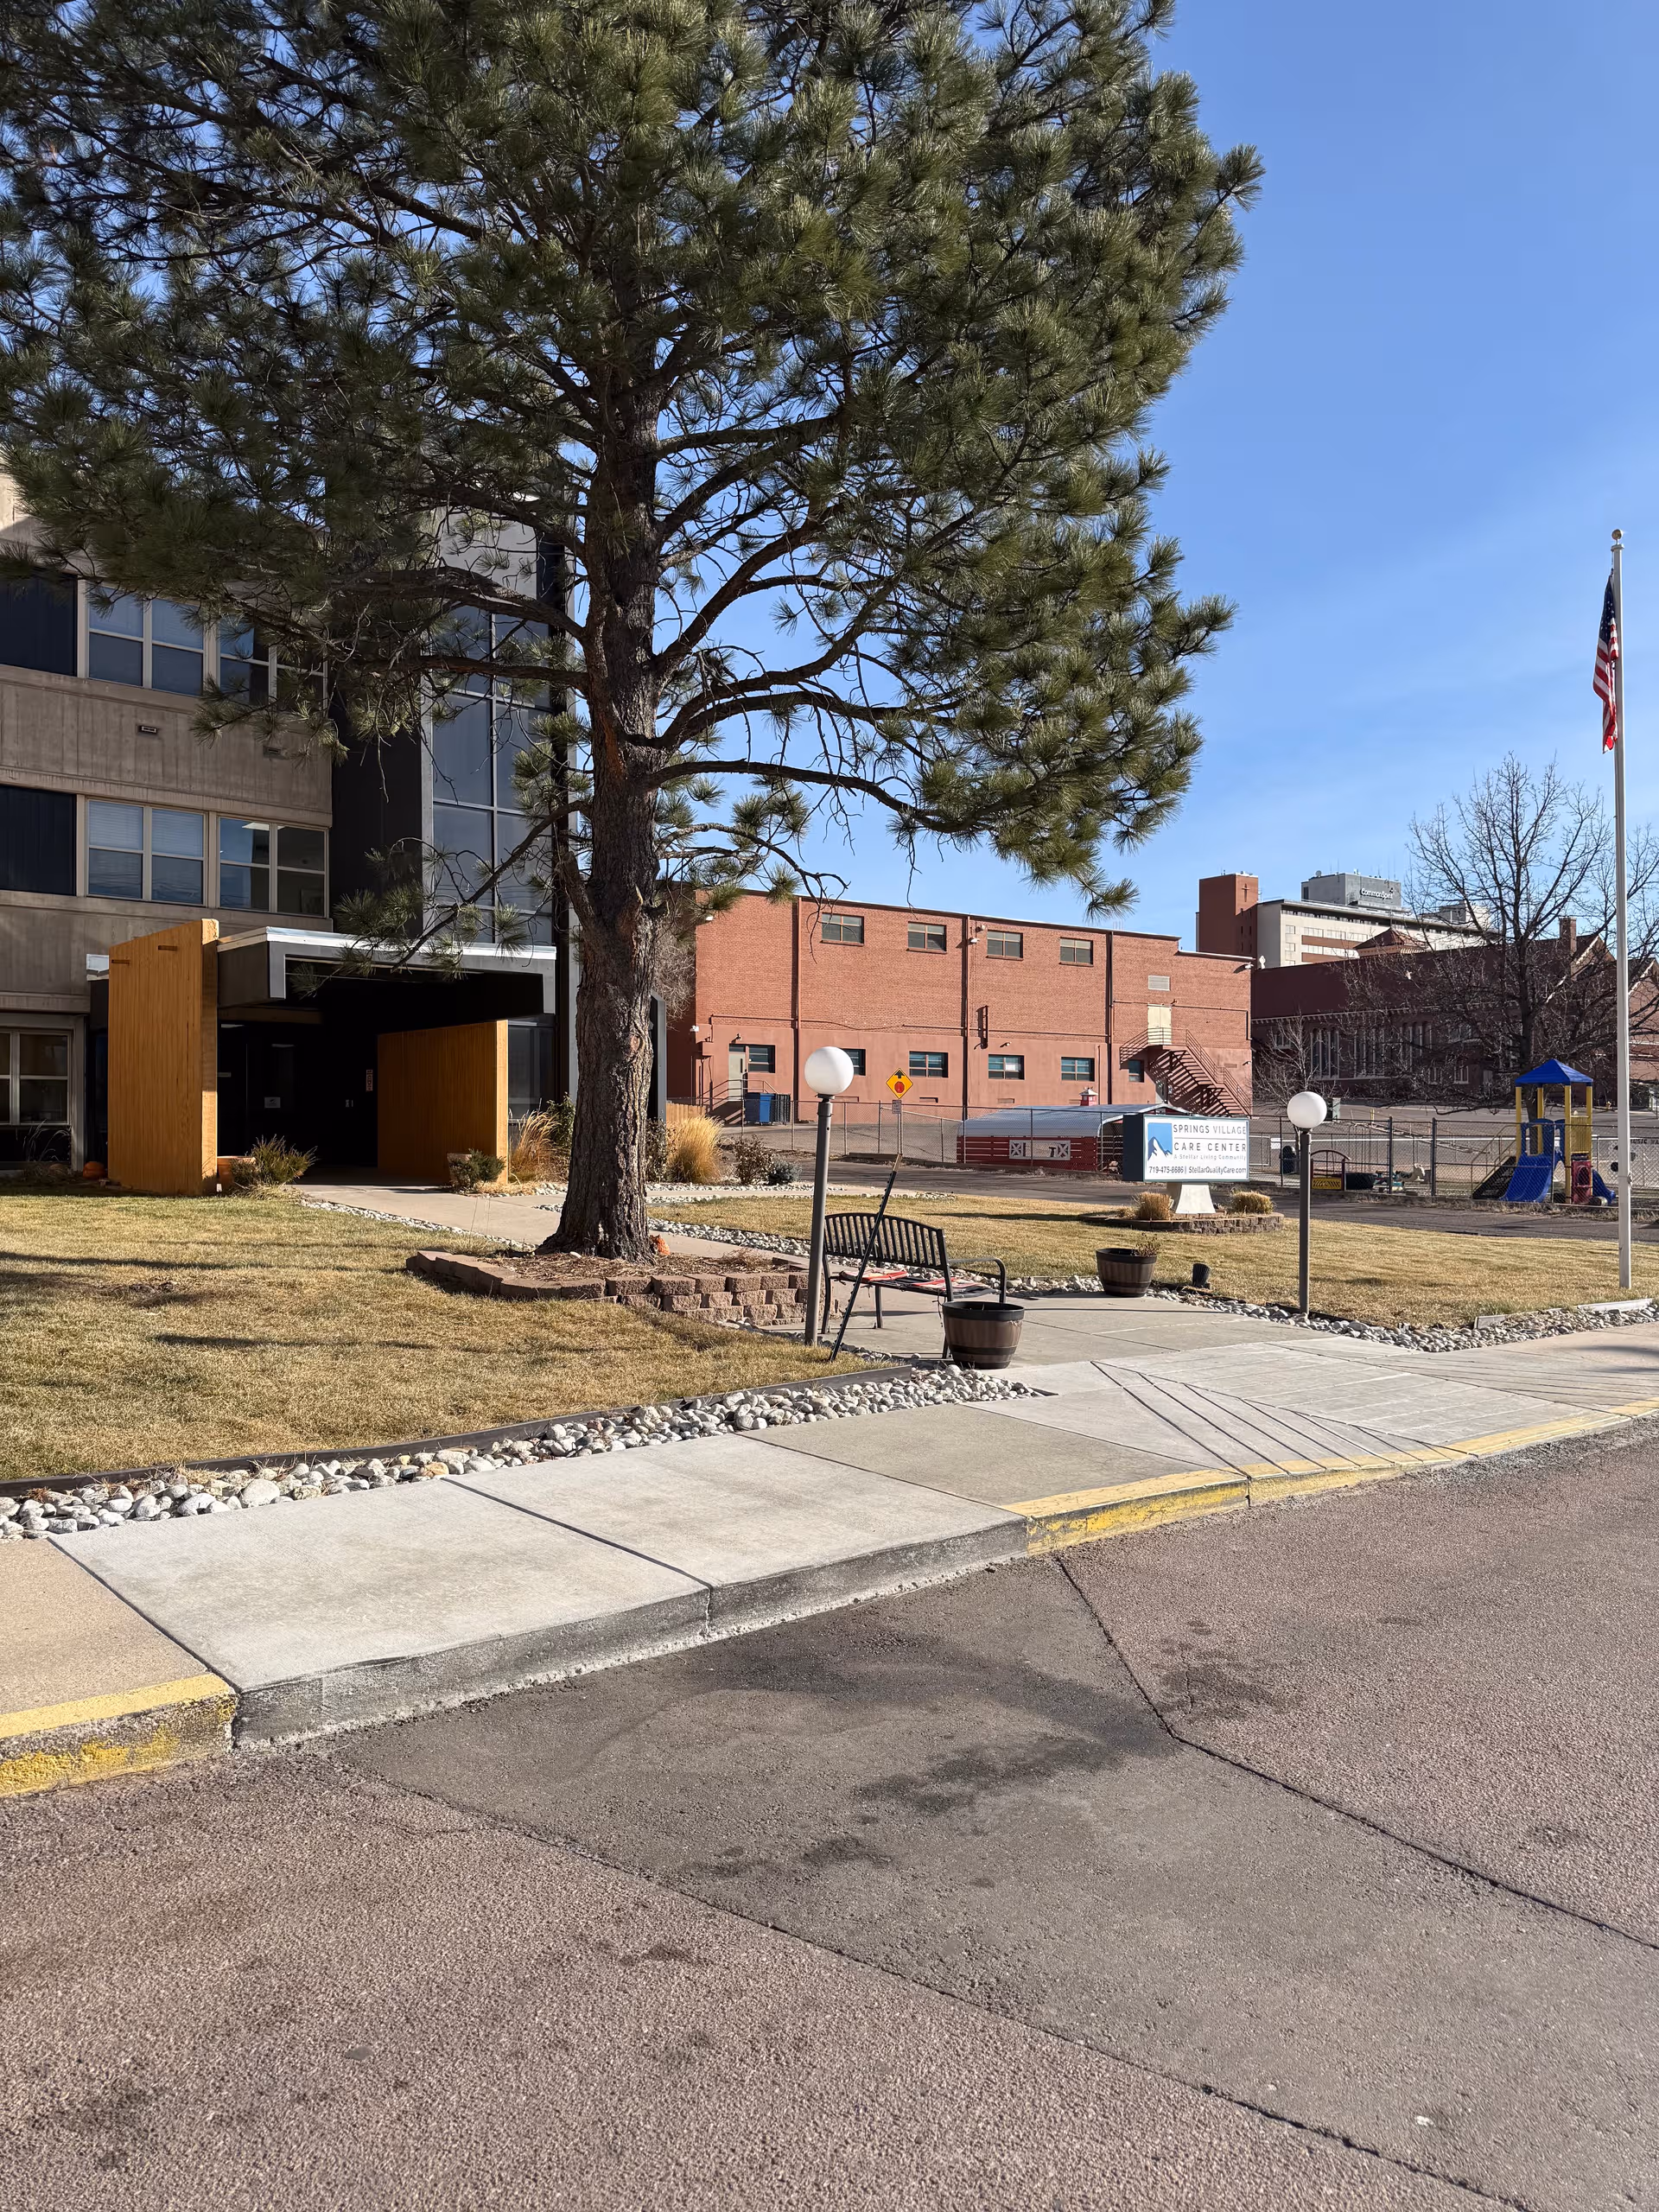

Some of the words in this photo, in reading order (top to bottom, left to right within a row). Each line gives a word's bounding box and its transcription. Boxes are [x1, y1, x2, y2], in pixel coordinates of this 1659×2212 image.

[1360, 887, 1394, 899] CommonSpirit
[1173, 1124, 1210, 1134] SPRINGS
[1212, 1125, 1246, 1135] VILLAGE
[1173, 1142, 1201, 1151] CARE
[1207, 1142, 1246, 1152] CENTER
[1188, 1166, 1246, 1175] StellarQualityCare.com
